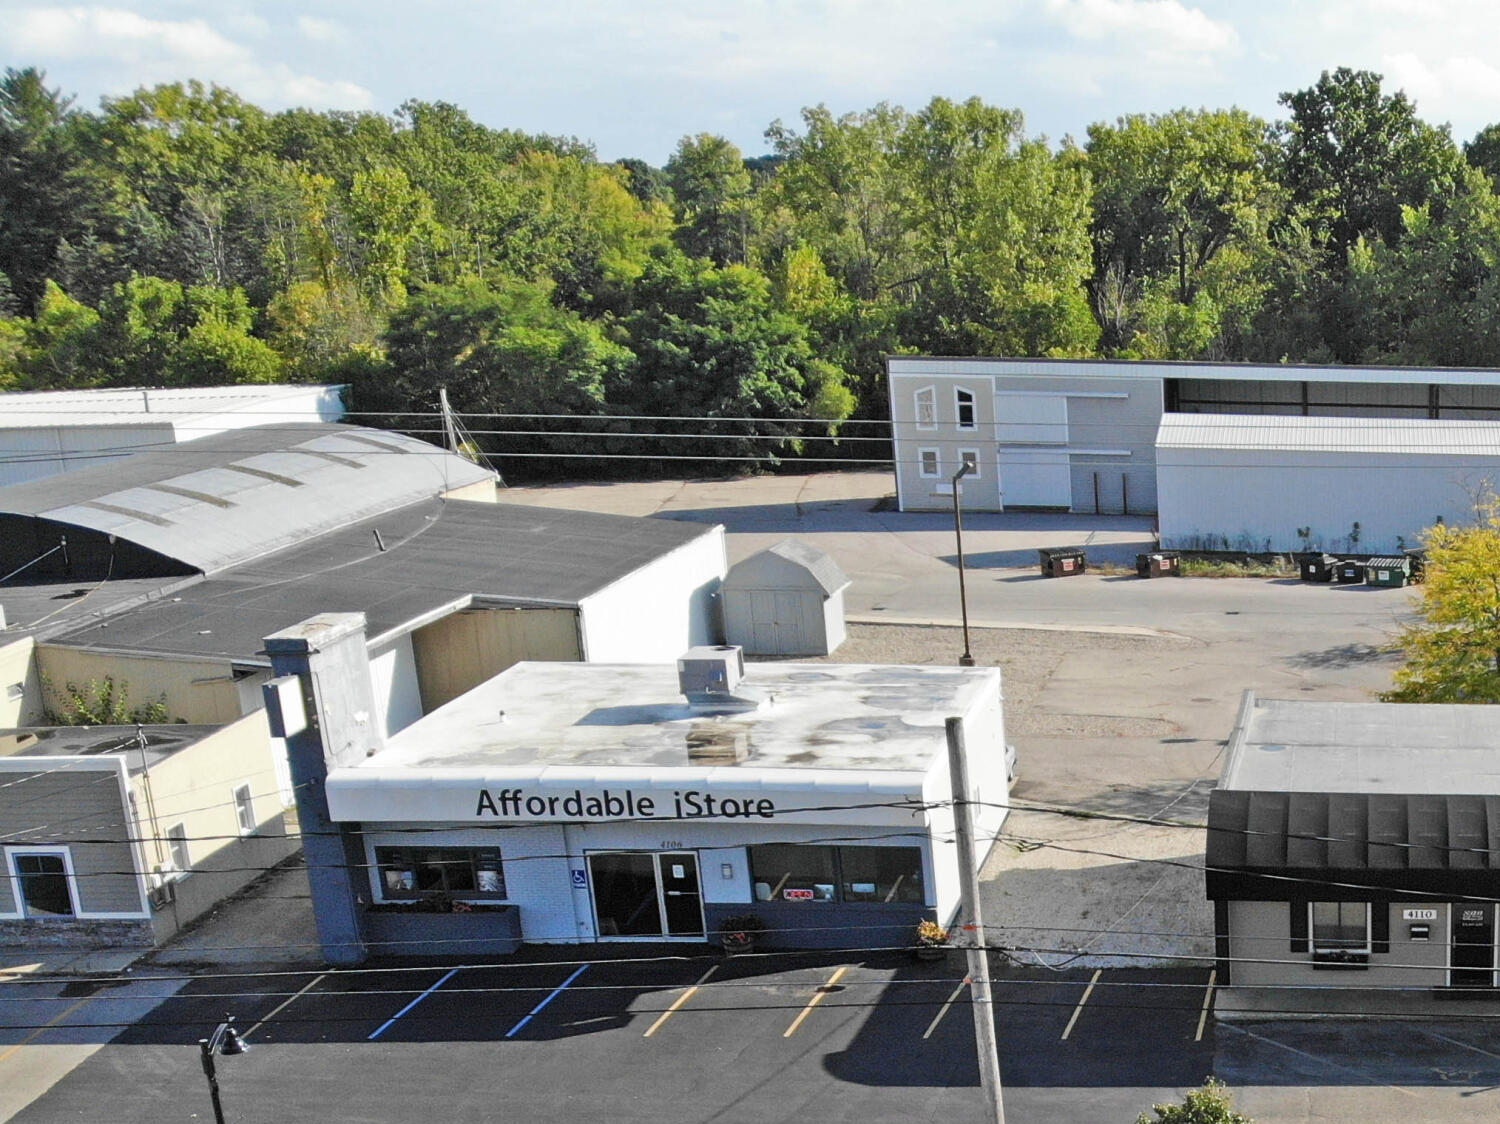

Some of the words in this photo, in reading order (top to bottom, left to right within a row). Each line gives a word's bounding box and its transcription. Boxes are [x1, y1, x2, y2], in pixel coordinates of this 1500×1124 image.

[476, 788, 655, 817] Affordable
[673, 790, 775, 819] iStore
[660, 841, 682, 849] 4106
[785, 889, 813, 900] OPEN
[1408, 910, 1432, 919] 4110
